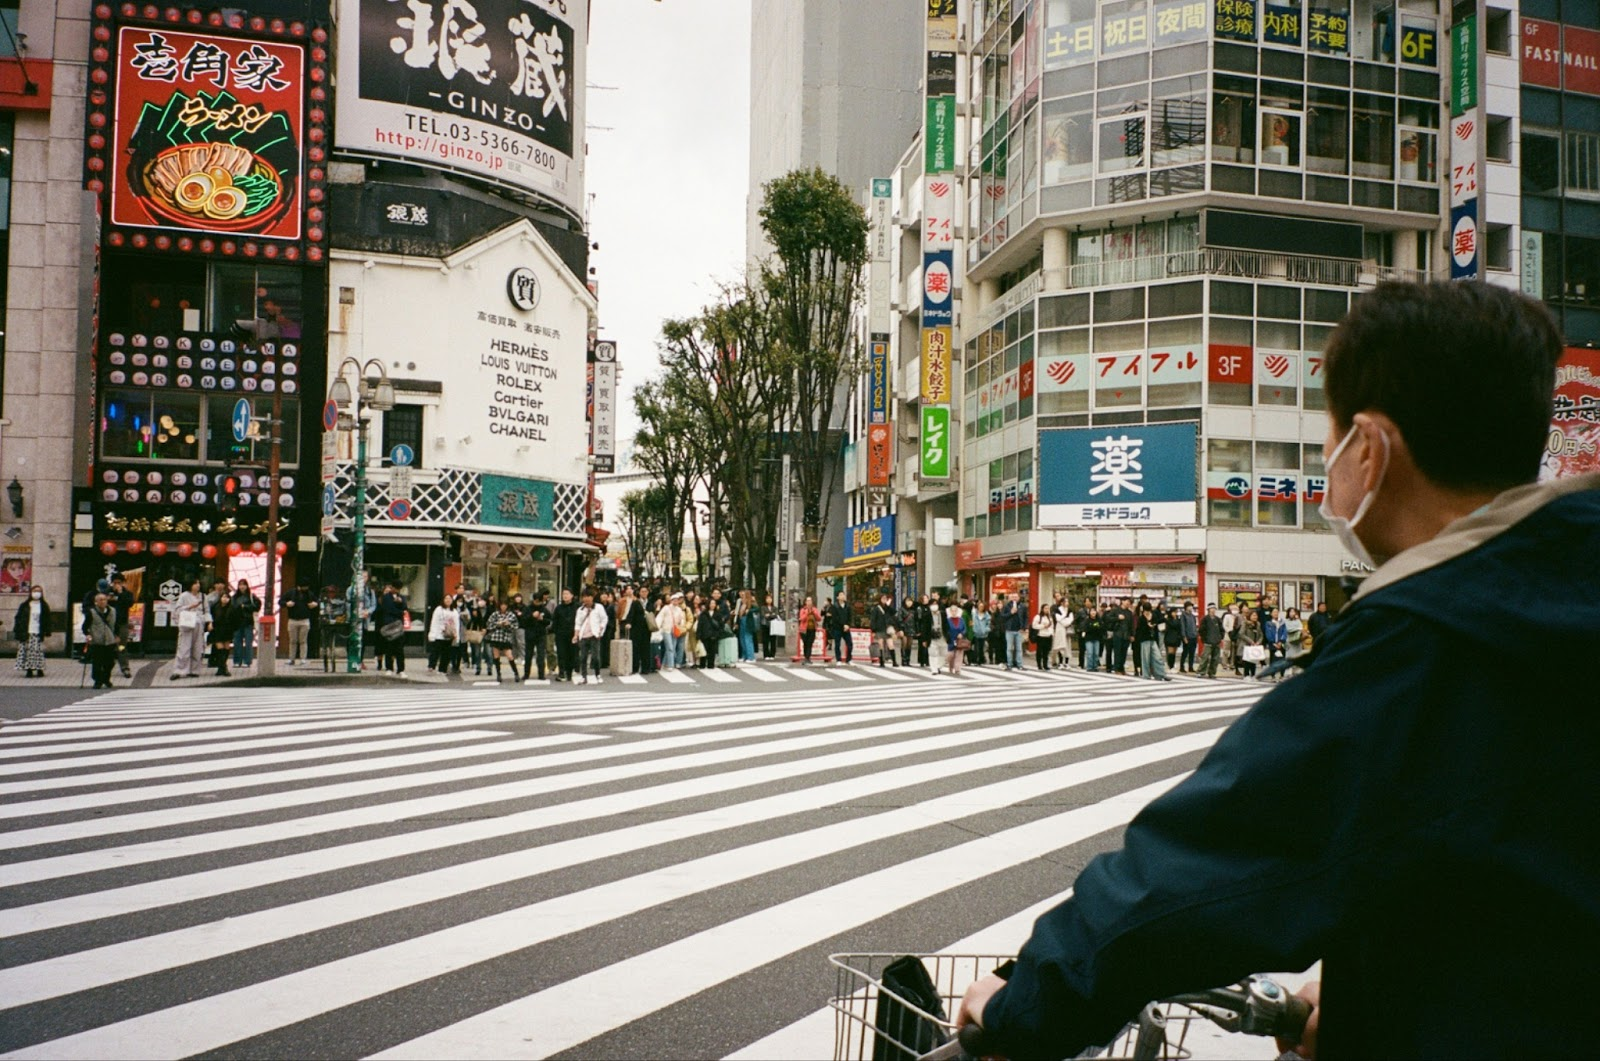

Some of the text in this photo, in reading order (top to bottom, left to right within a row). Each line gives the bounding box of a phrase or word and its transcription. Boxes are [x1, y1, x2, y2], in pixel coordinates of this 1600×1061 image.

[1216, 0, 1254, 18] 保険
[1104, 16, 1147, 46] 祝日
[1157, 4, 1206, 36] 夜間
[1216, 15, 1254, 36] 診療
[1263, 11, 1299, 39] 内科
[1309, 13, 1347, 32] 予約
[1525, 23, 1539, 36] 6F
[1309, 29, 1347, 49] 不要
[1401, 33, 1433, 60] 6F
[131, 33, 291, 92] 壱角家
[1525, 45, 1598, 71] FASTNAIL
[179, 97, 272, 134] ラーメン
[375, 128, 503, 170] http://ginzo.jp
[405, 113, 556, 171] TEL.03-5366-7800
[1454, 228, 1475, 256] 薬
[516, 274, 535, 306] 質
[926, 272, 949, 293] 薬
[477, 311, 517, 328] 高価買取
[134, 335, 294, 356] YOKOHMA
[490, 338, 549, 362] HERMÈS
[481, 353, 558, 380] LOUIS VUITTON
[928, 331, 945, 401] 肉汁水餃子
[1096, 351, 1199, 379] アイフル
[1218, 356, 1242, 376] 3F
[155, 375, 256, 388] RAMEN
[496, 373, 542, 393] ROLEX
[1022, 370, 1033, 392] 3F
[493, 390, 544, 410] Cartier
[489, 405, 549, 427] BVLGARI
[489, 422, 547, 442] CHANEL
[925, 415, 944, 465] レイク
[1089, 435, 1144, 497] 薬
[125, 491, 247, 503] KAKUA
